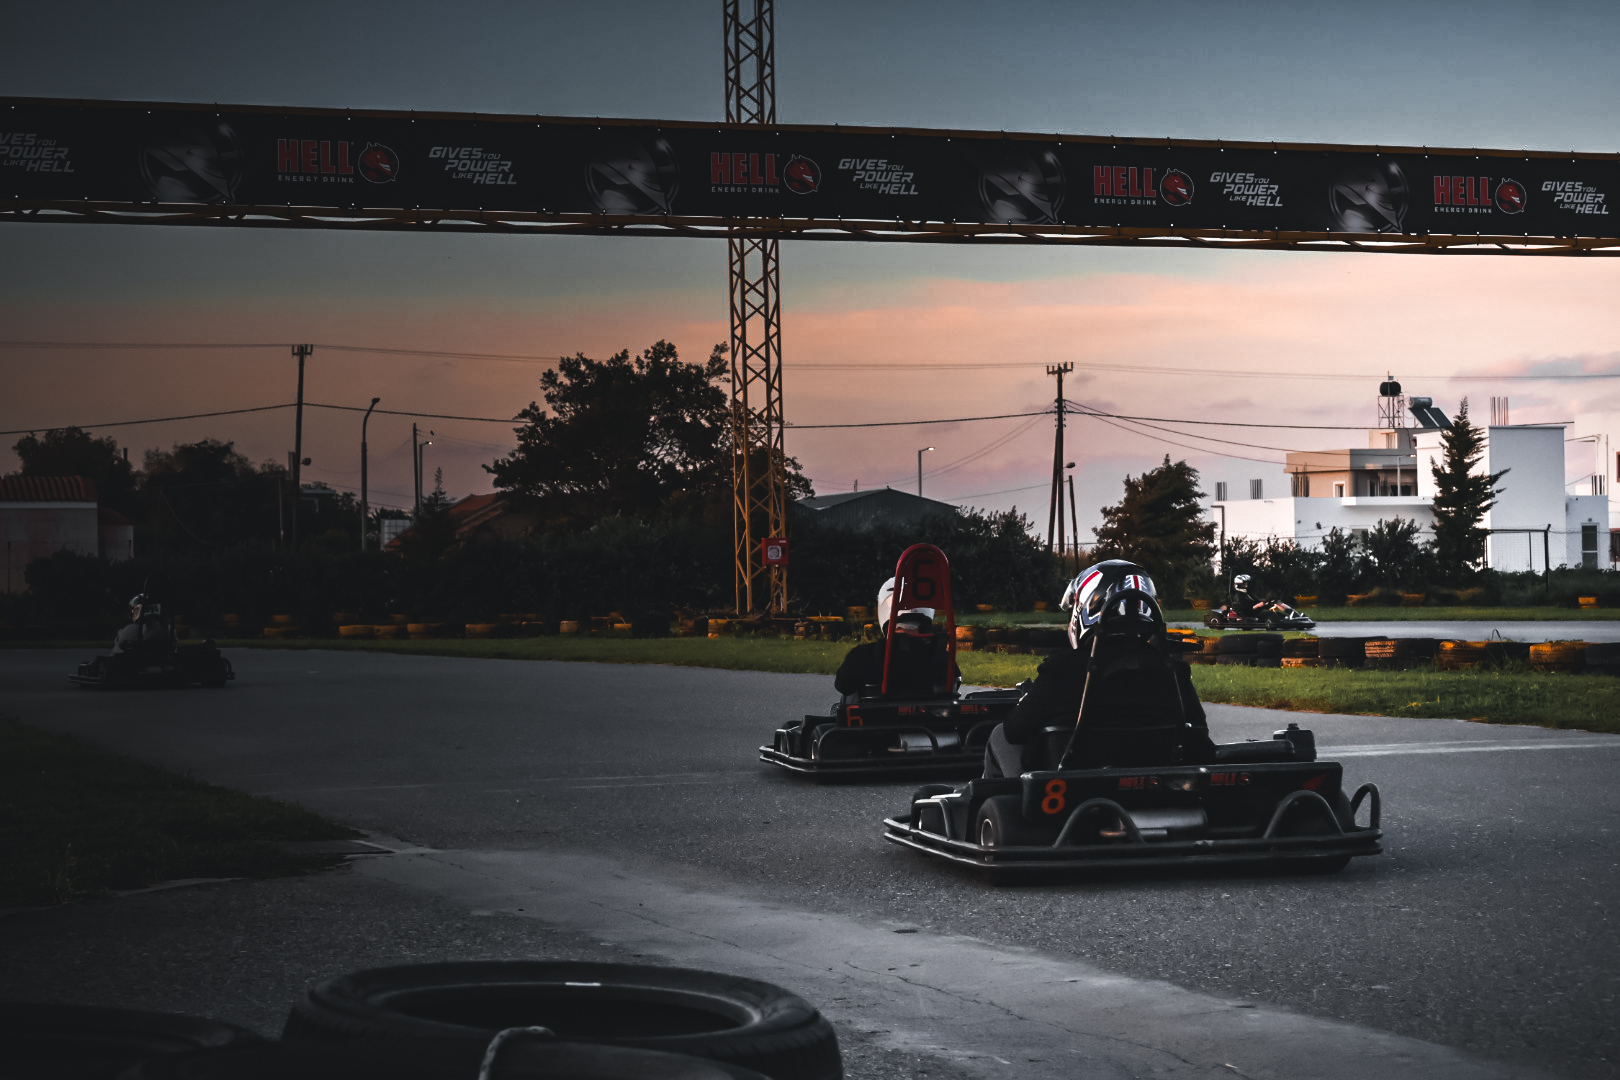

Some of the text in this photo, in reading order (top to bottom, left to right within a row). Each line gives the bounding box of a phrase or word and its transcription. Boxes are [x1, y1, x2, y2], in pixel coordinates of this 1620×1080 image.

[0, 133, 37, 146] VES
[0, 145, 69, 159] POWER
[278, 139, 353, 174] HELL
[429, 146, 483, 159] GIVES
[26, 160, 75, 173] HELL
[444, 159, 512, 173] POWER
[711, 152, 779, 185] HELL
[838, 158, 888, 170] GIVES
[322, 176, 354, 184] DRINK
[472, 172, 518, 185] HELL
[852, 170, 914, 183] POWER
[1094, 165, 1157, 197] HELL
[1209, 171, 1255, 184] GIVES
[859, 182, 919, 195] LIKE HELL
[1223, 183, 1279, 196] POWER
[1434, 175, 1492, 206] HELL
[1541, 181, 1583, 192] GIVES
[1094, 197, 1127, 205] ENERGY
[1246, 195, 1283, 207] HELL
[1553, 192, 1605, 204] POWER
[1575, 203, 1609, 215] HELL
[912, 560, 936, 601] 6
[1041, 778, 1068, 815] 8
